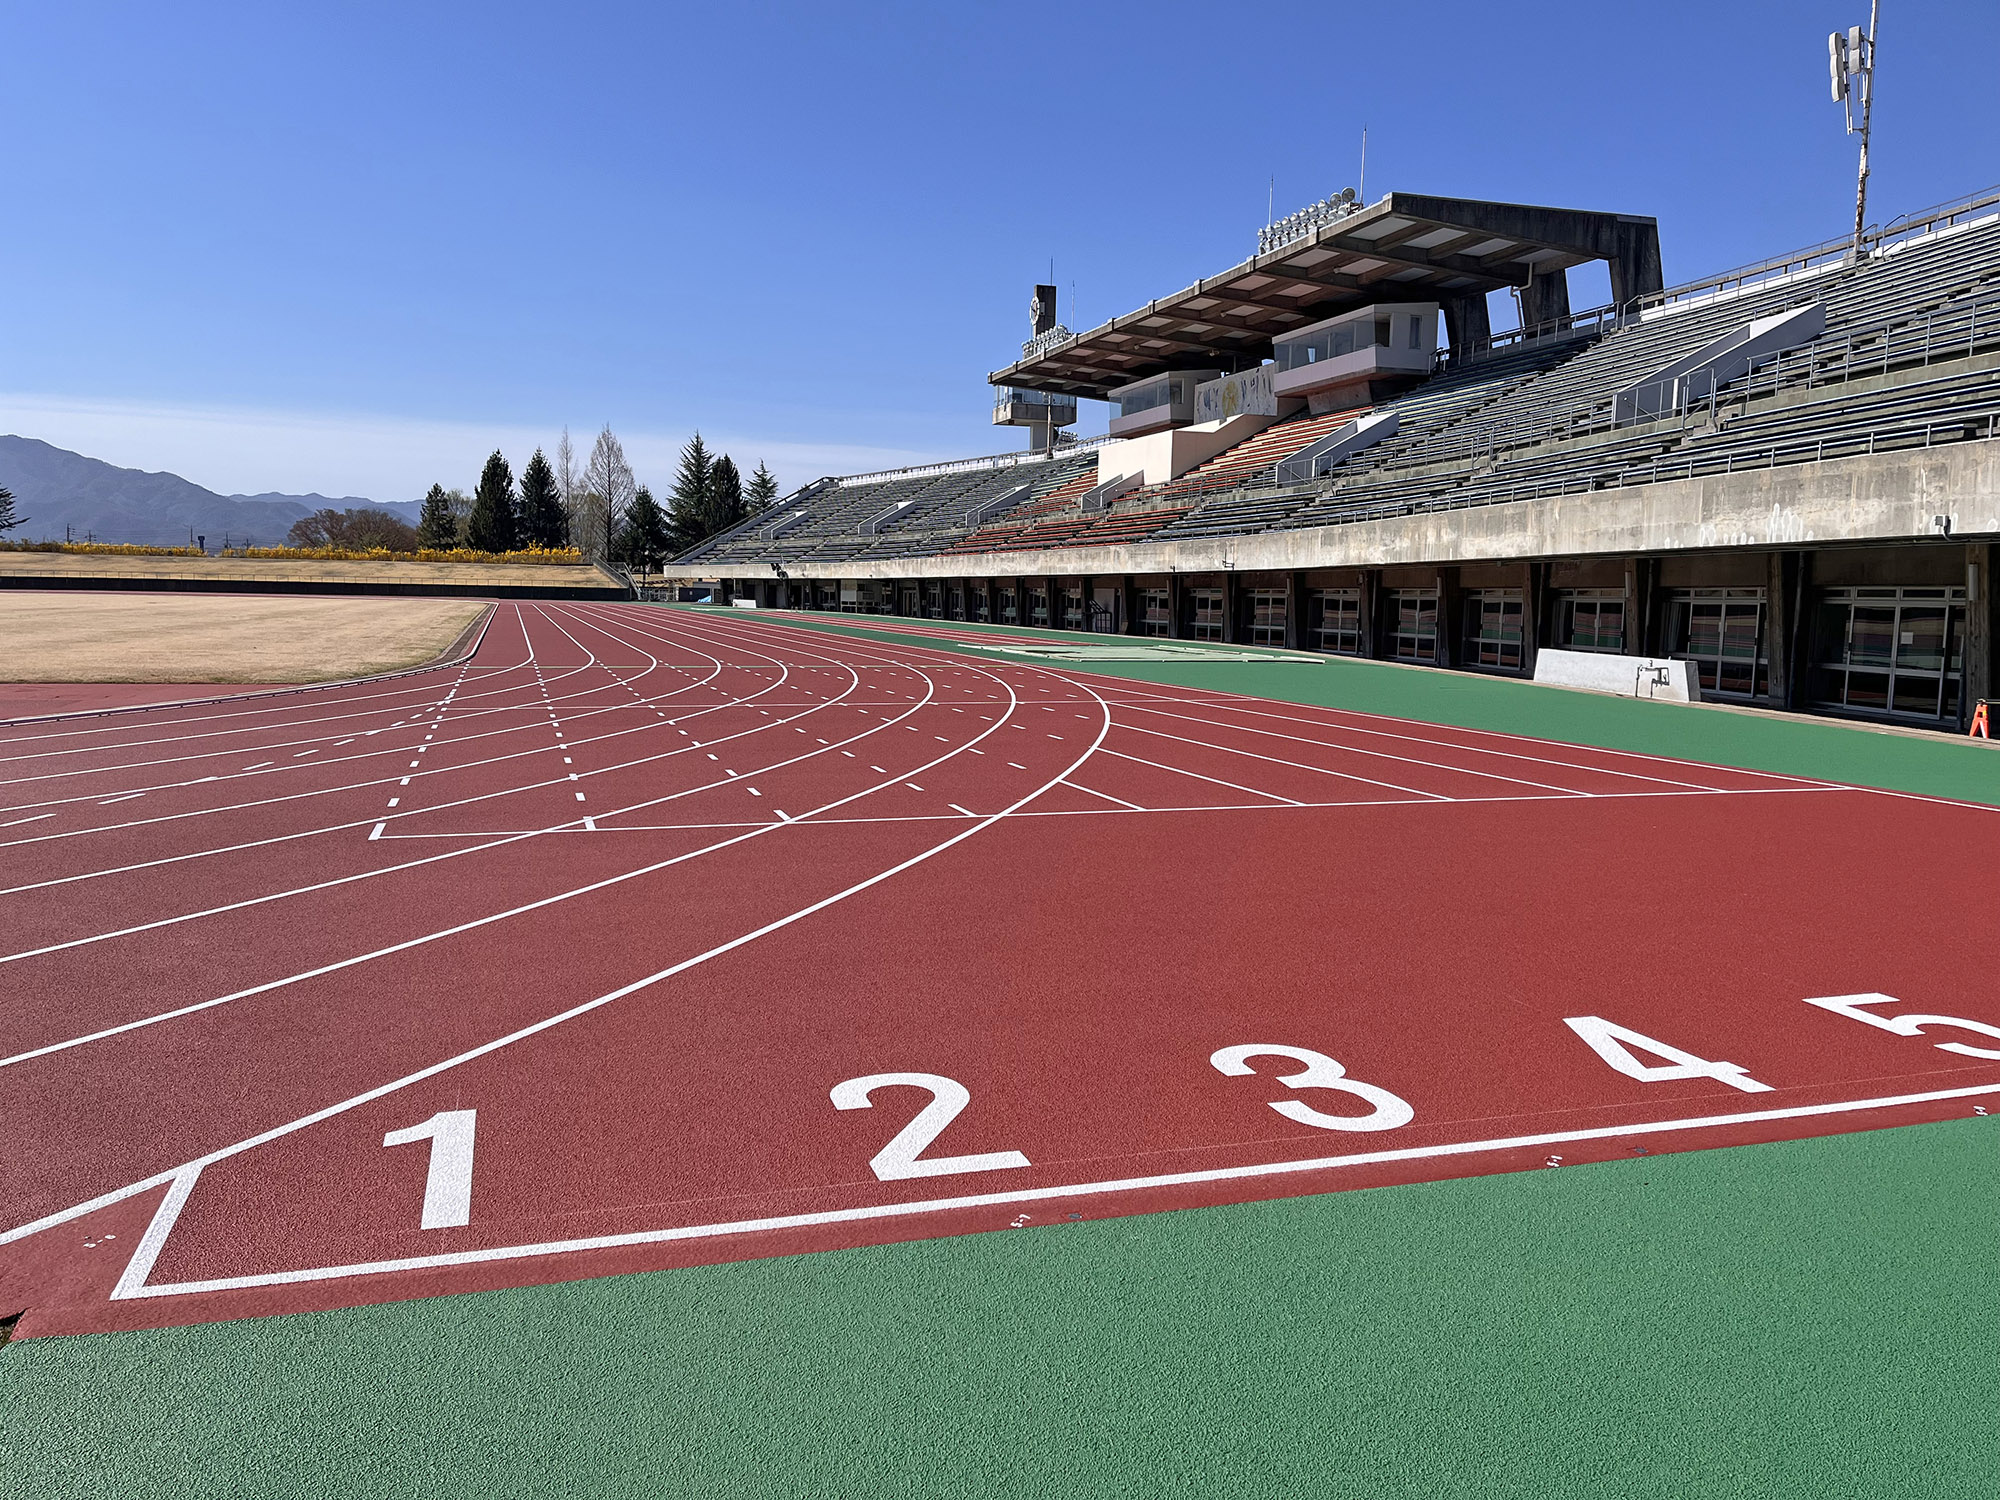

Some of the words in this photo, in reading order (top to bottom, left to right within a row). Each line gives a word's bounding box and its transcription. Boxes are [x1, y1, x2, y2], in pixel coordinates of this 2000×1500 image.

[1562, 1015, 1776, 1094] 4
[1802, 992, 2000, 1060] 5
[830, 1072, 1031, 1182] 2
[1209, 1043, 1415, 1132] 3
[383, 1108, 476, 1230] 1
